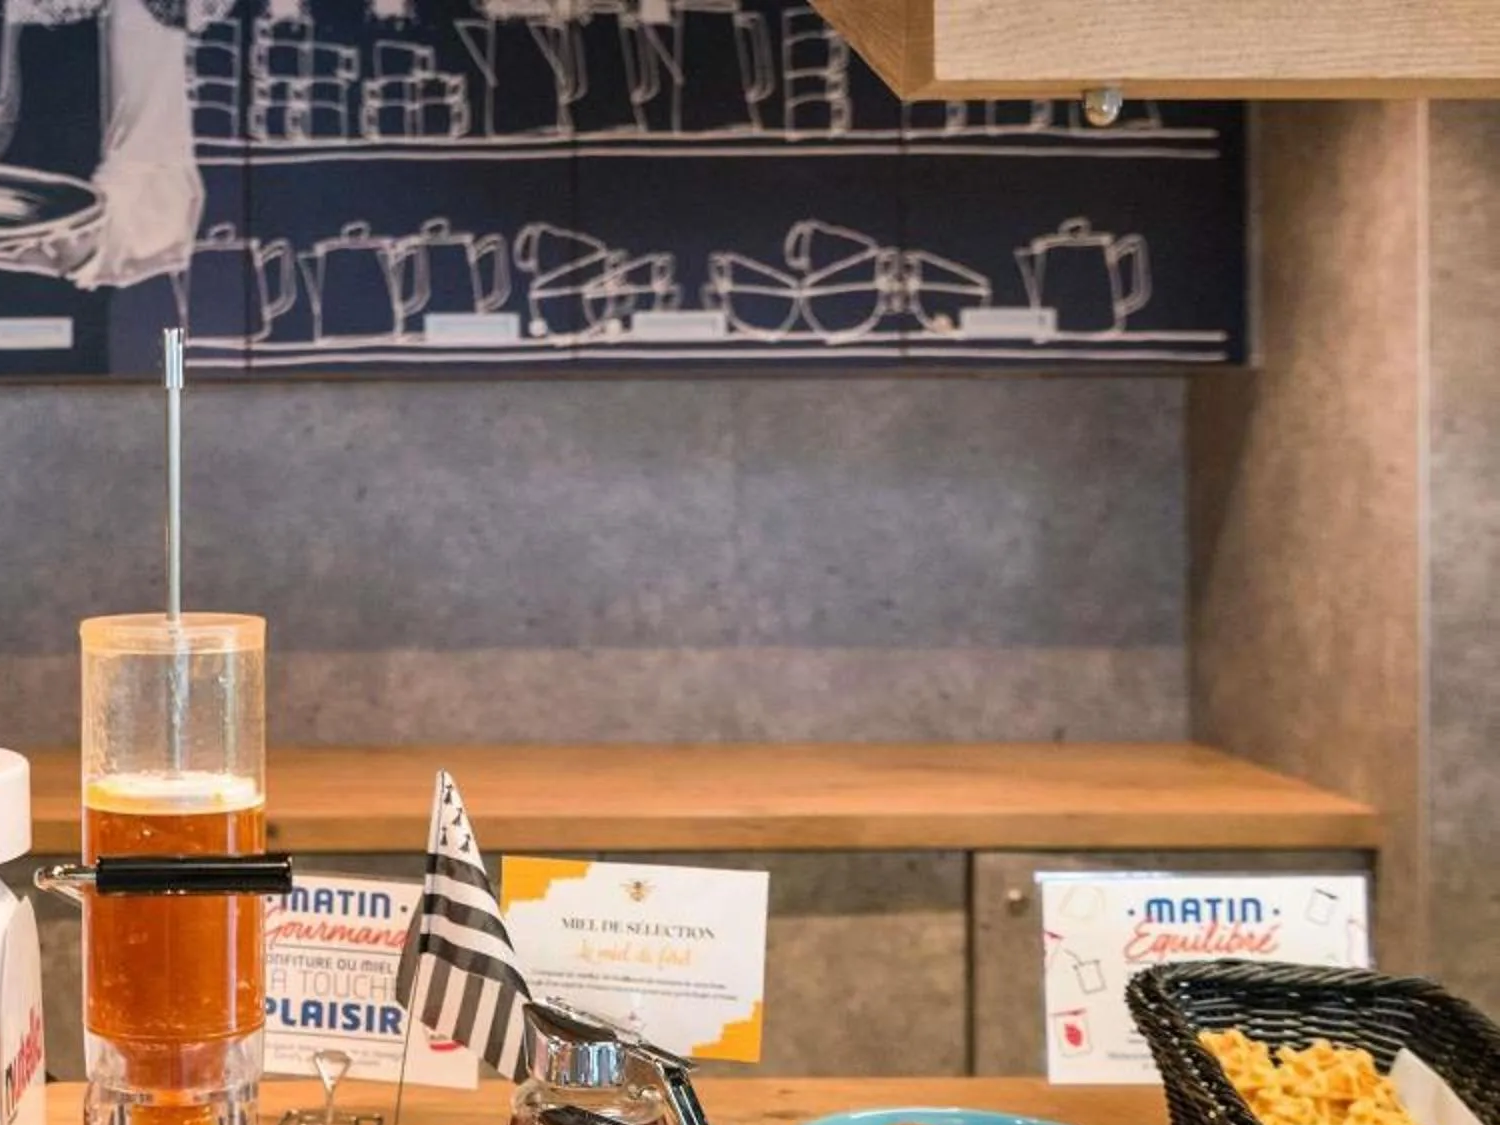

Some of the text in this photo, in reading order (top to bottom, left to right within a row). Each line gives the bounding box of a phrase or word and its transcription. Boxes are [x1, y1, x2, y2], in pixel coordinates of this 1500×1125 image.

[281, 886, 391, 918] MATIN
[1145, 897, 1262, 923] MATIN
[360, 959, 395, 974] MIEL
[264, 996, 403, 1035] PLAISIR
